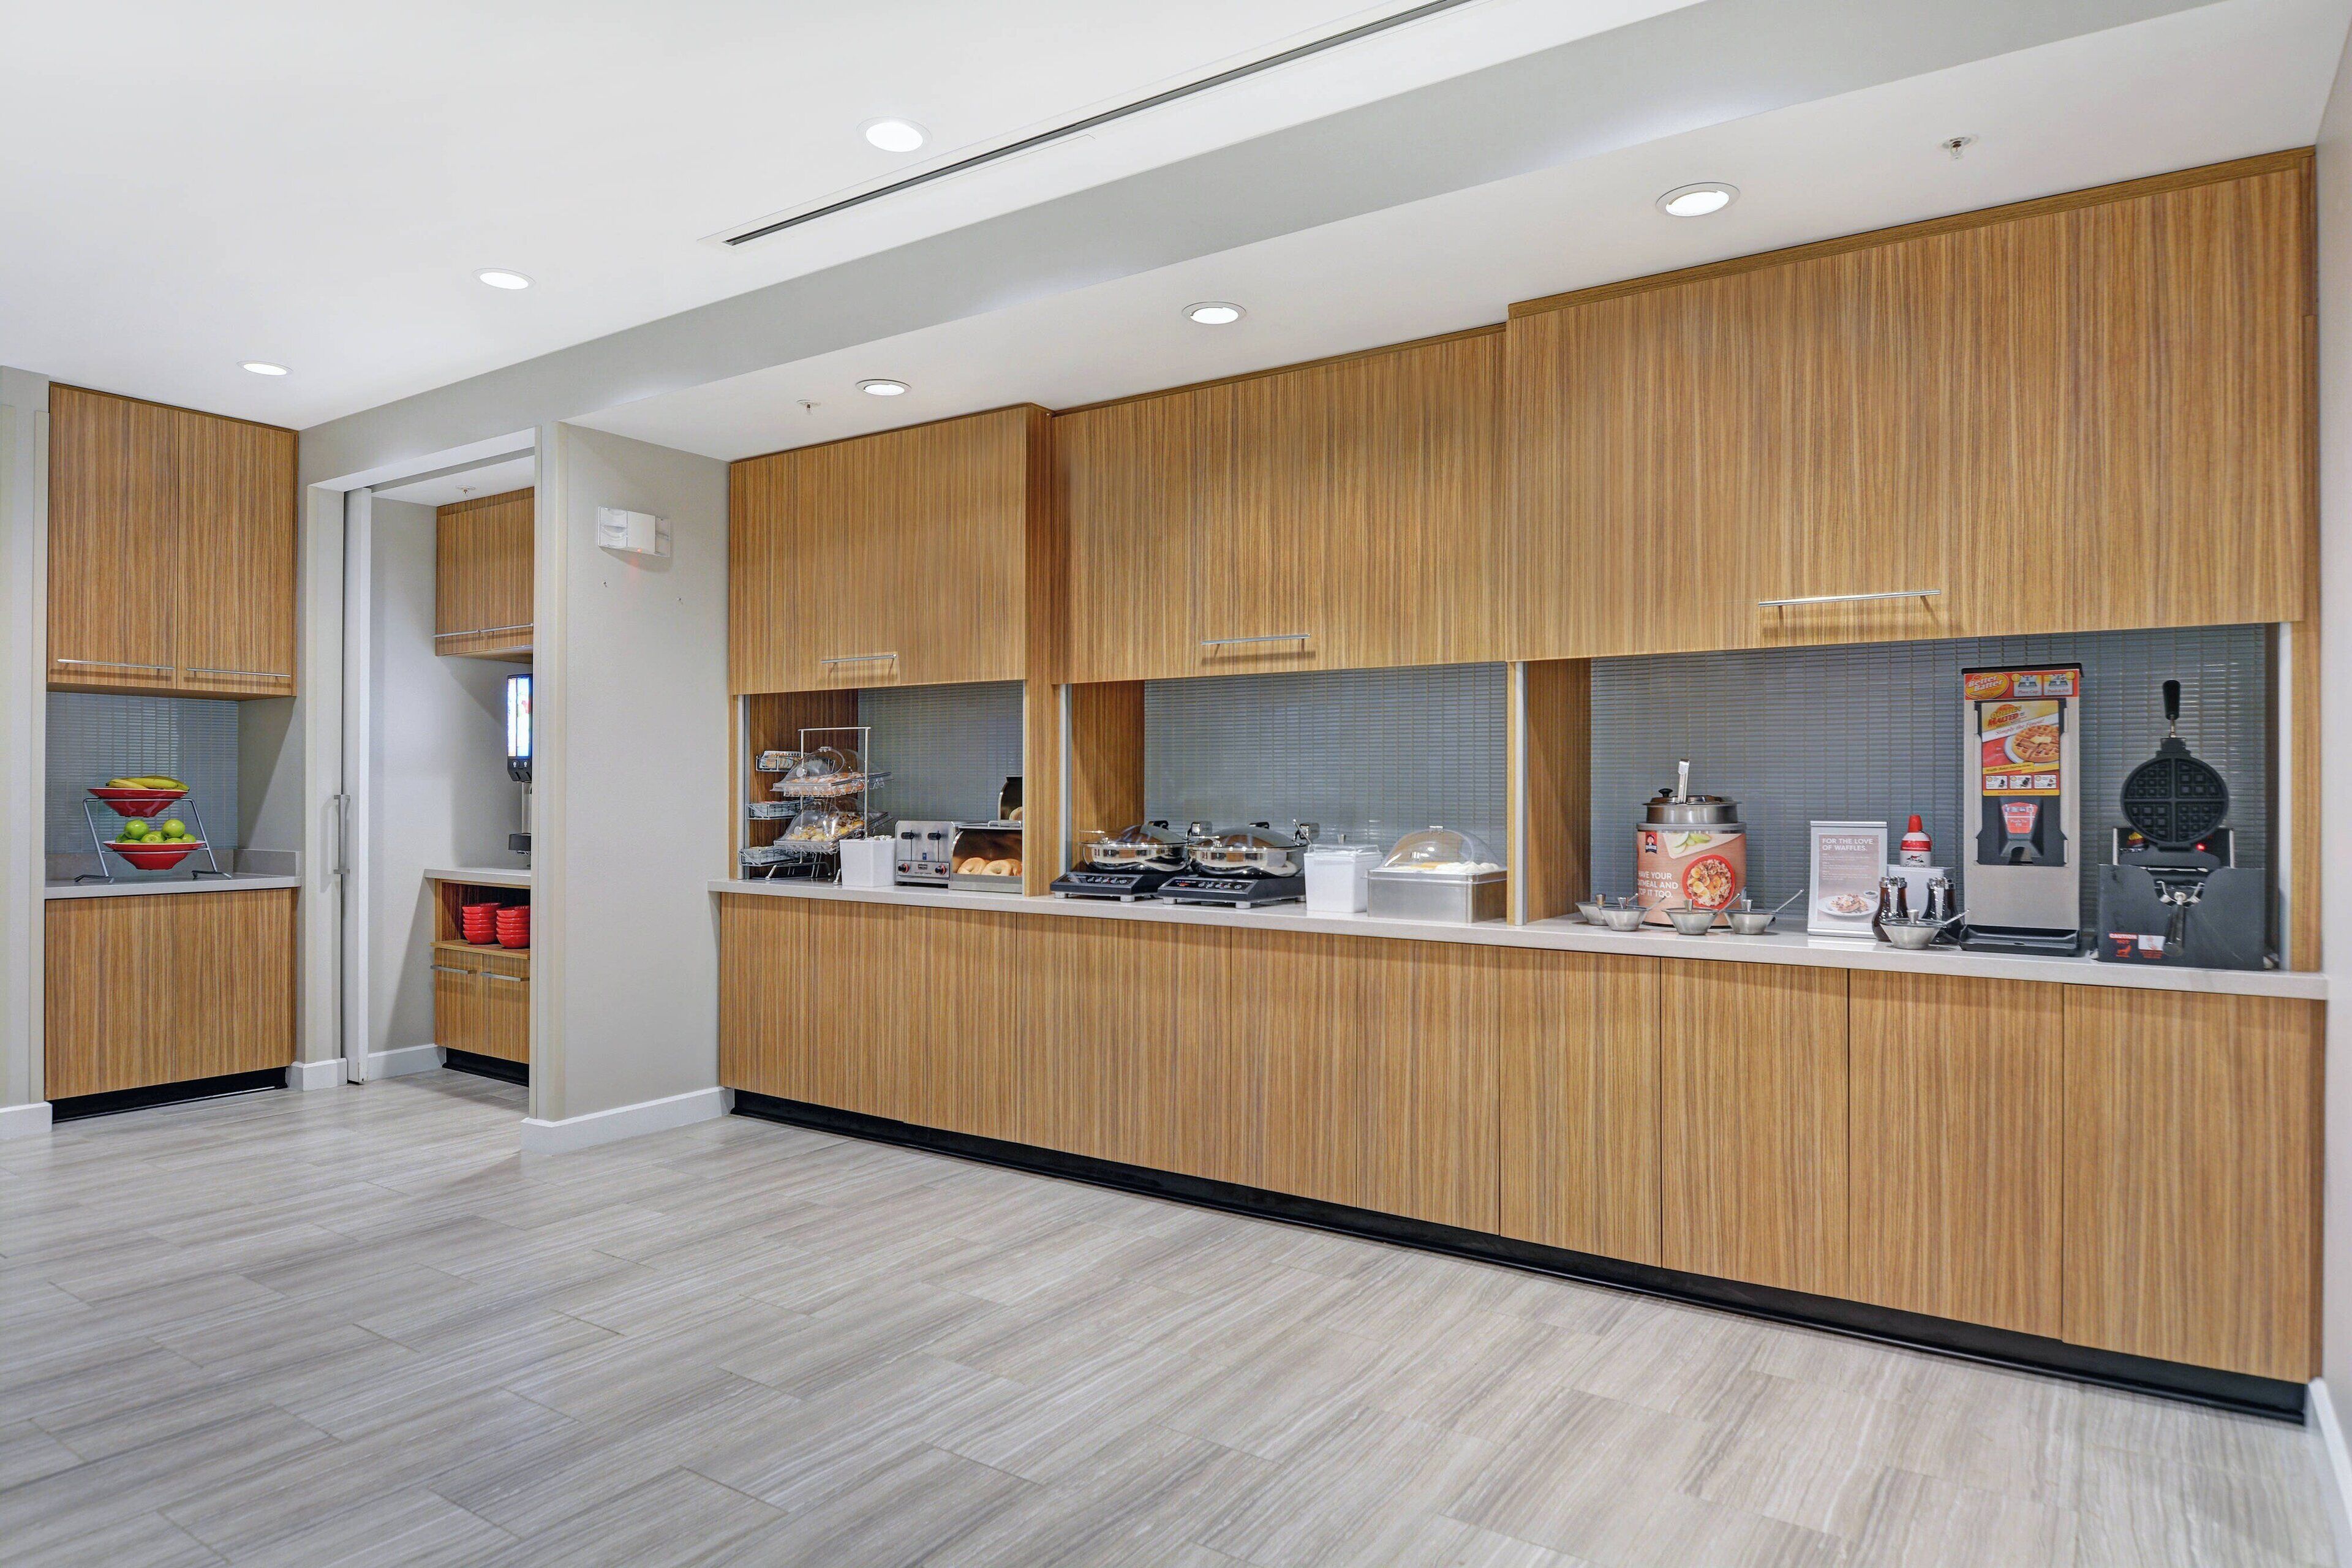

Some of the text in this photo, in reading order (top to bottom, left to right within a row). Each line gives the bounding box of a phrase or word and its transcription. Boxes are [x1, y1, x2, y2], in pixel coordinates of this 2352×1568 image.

[1968, 676, 1999, 688] Better
[1974, 680, 2004, 692] Batter
[1988, 713, 2019, 726] MALTED
